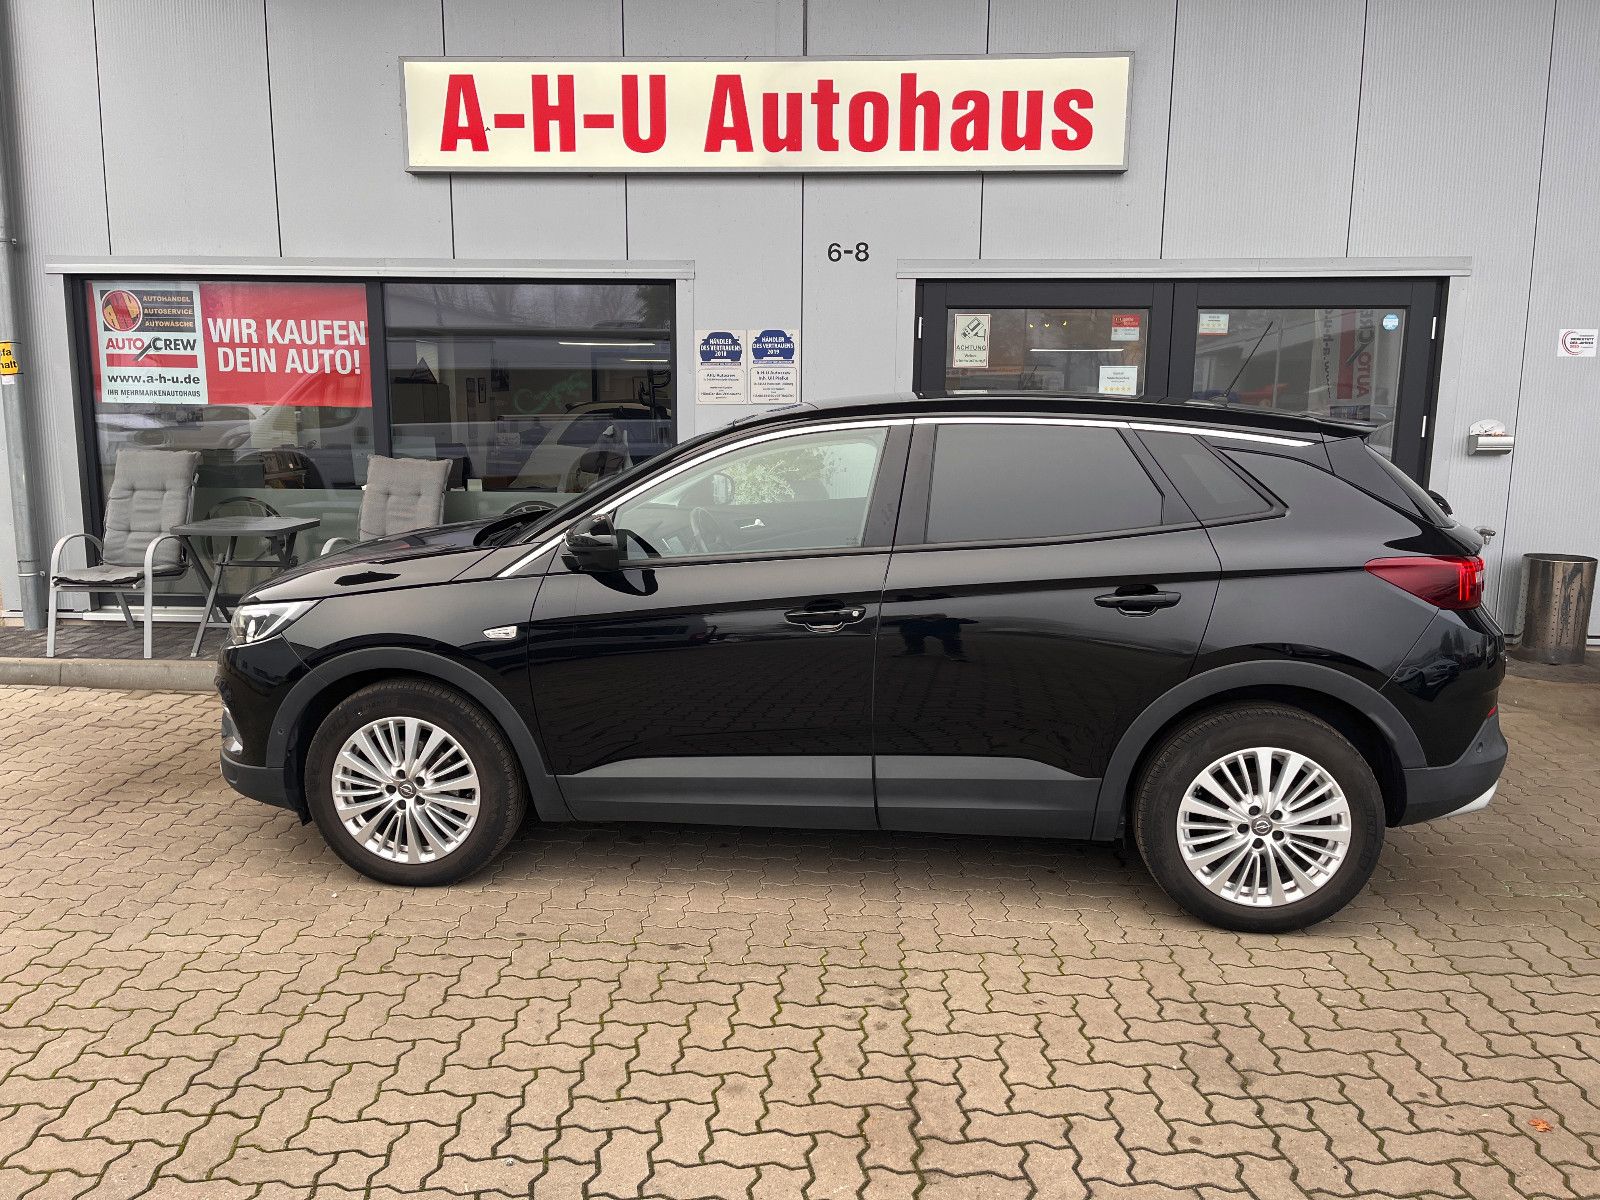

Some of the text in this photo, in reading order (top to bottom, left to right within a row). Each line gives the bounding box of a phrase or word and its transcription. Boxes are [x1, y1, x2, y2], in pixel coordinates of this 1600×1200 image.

[440, 73, 1094, 153] A-H-U Autohaus
[828, 242, 869, 262] 6-8
[207, 318, 367, 346] WIR KAUFEN
[105, 337, 197, 351] AUTO CREW
[217, 347, 361, 375] DEIN AUTO!
[107, 374, 200, 384] www.a-h-u.de
[120, 389, 201, 397] MEHRMARKENAUTOHAUS
